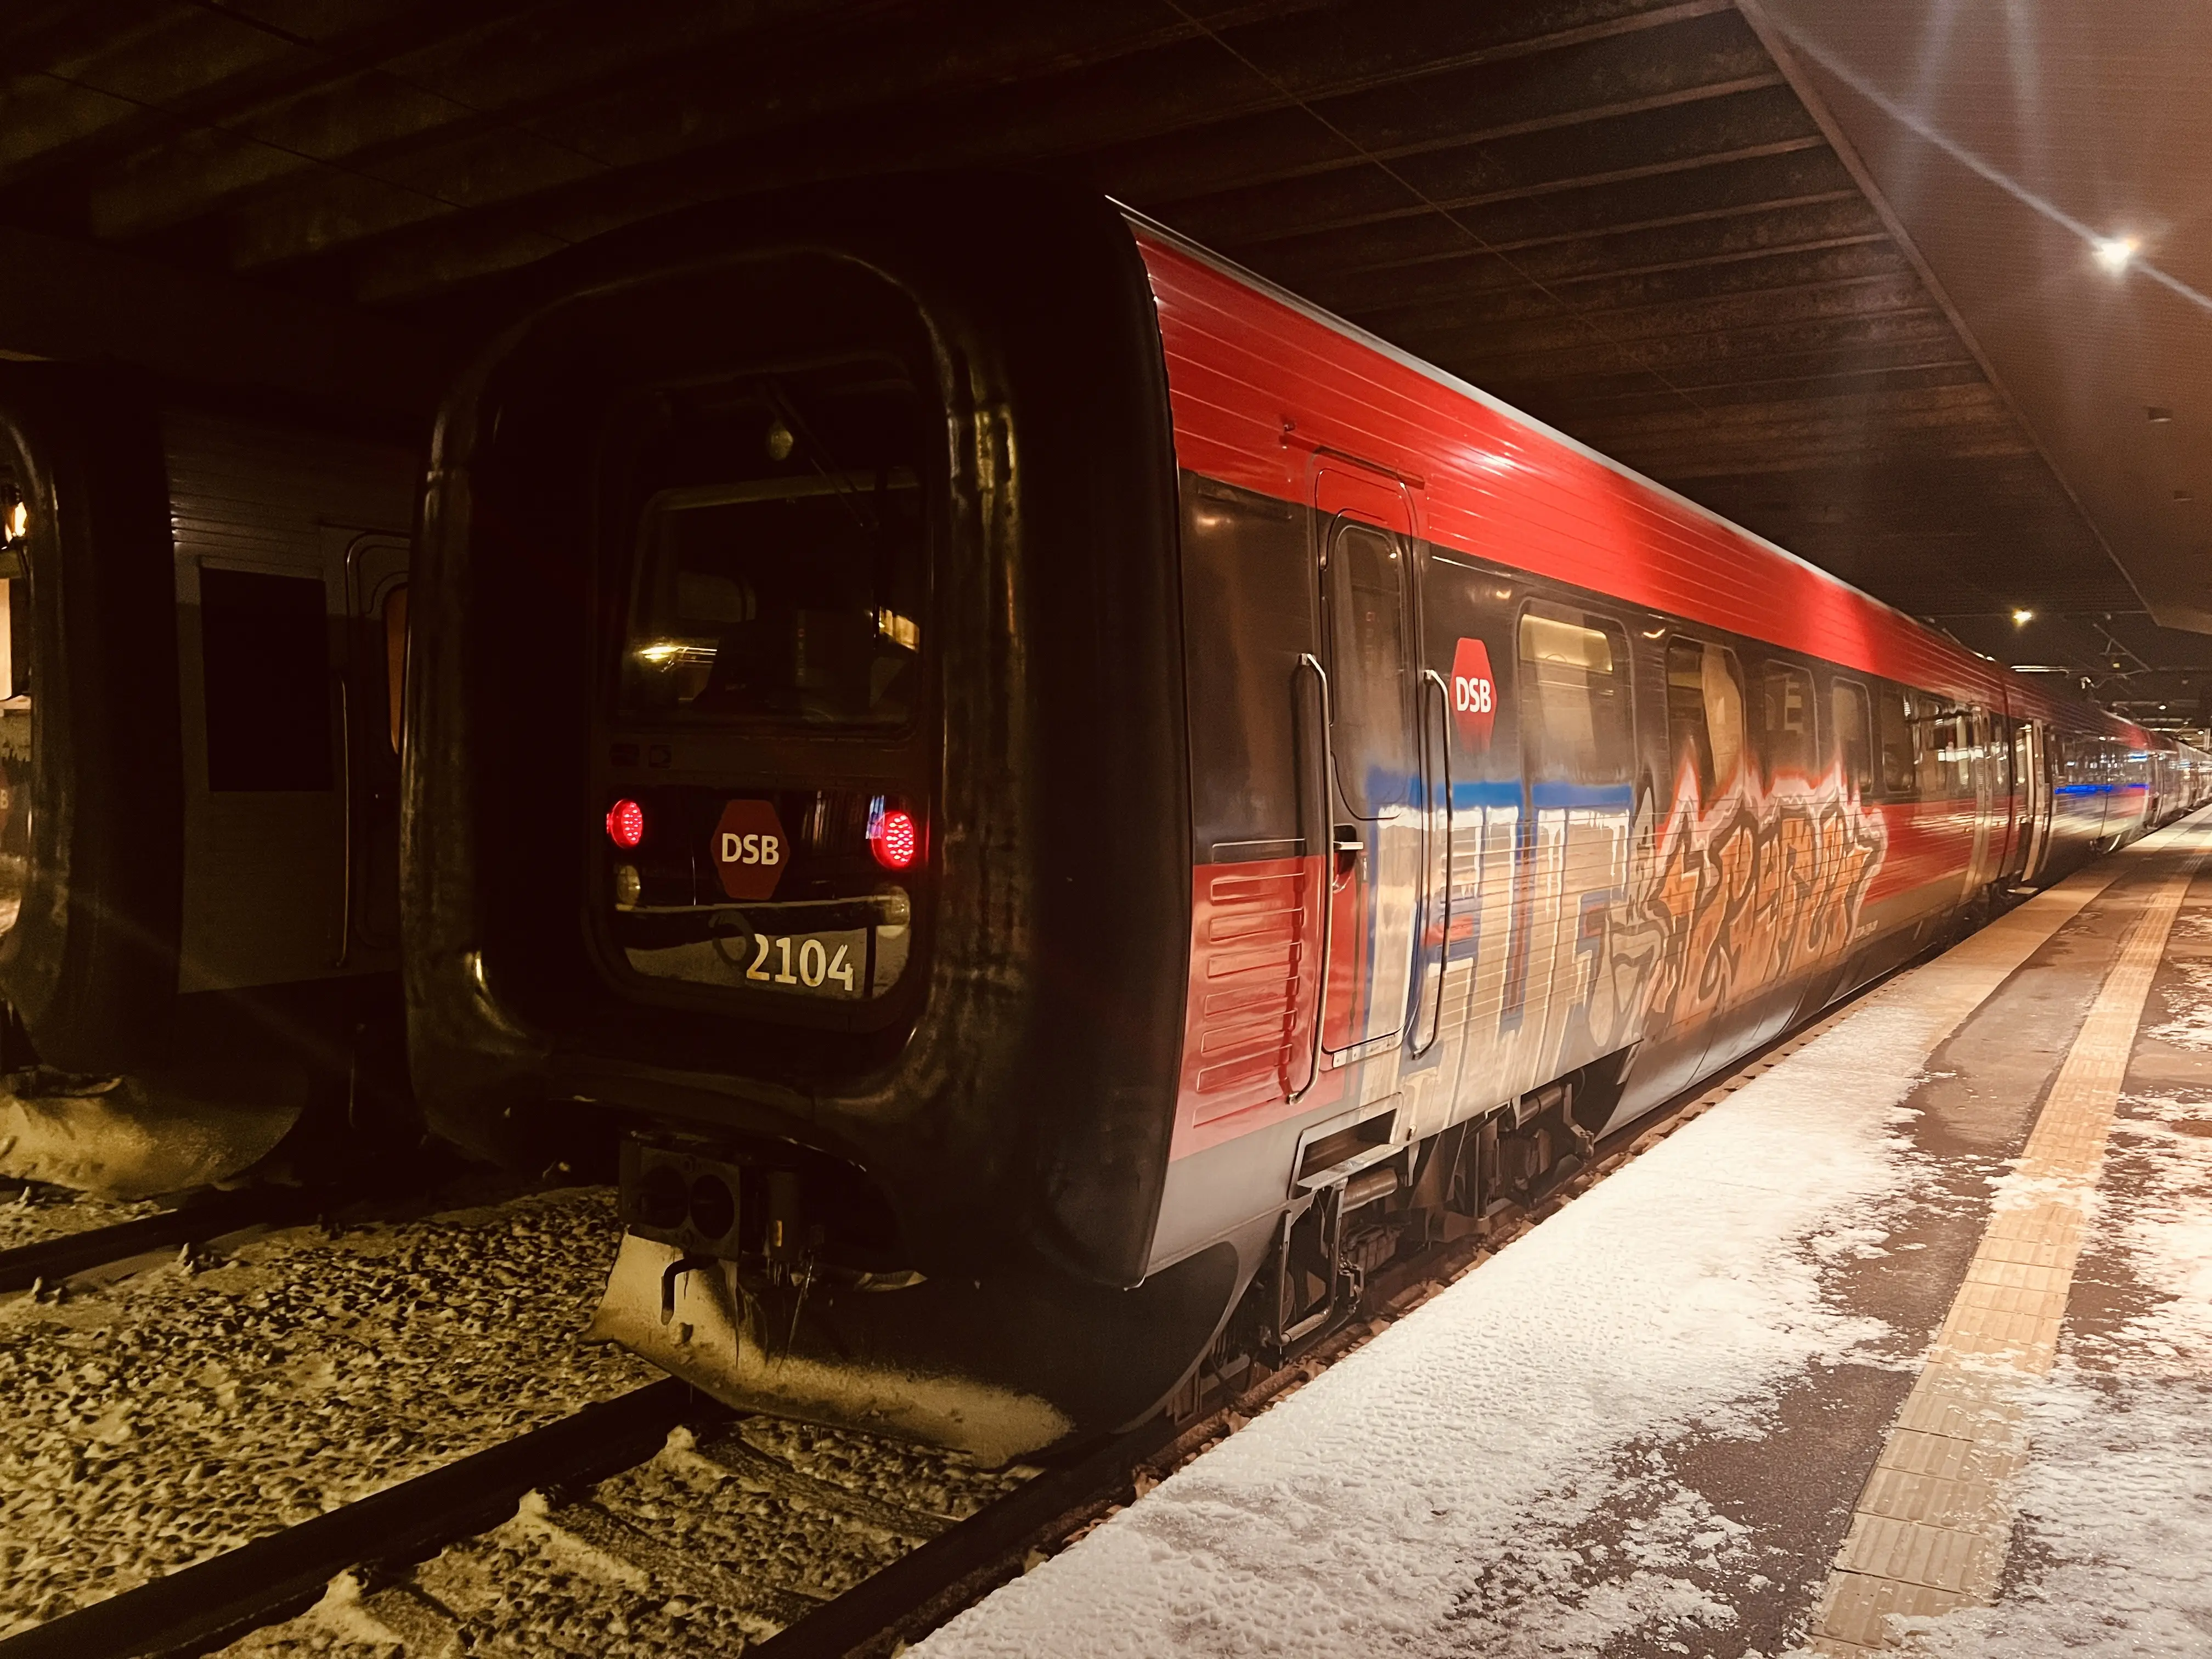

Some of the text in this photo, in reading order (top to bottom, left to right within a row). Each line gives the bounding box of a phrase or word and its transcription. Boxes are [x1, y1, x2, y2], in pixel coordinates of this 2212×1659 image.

[1455, 676, 1491, 713] DSB
[722, 833, 779, 865] DSB
[746, 934, 853, 991] 2104
